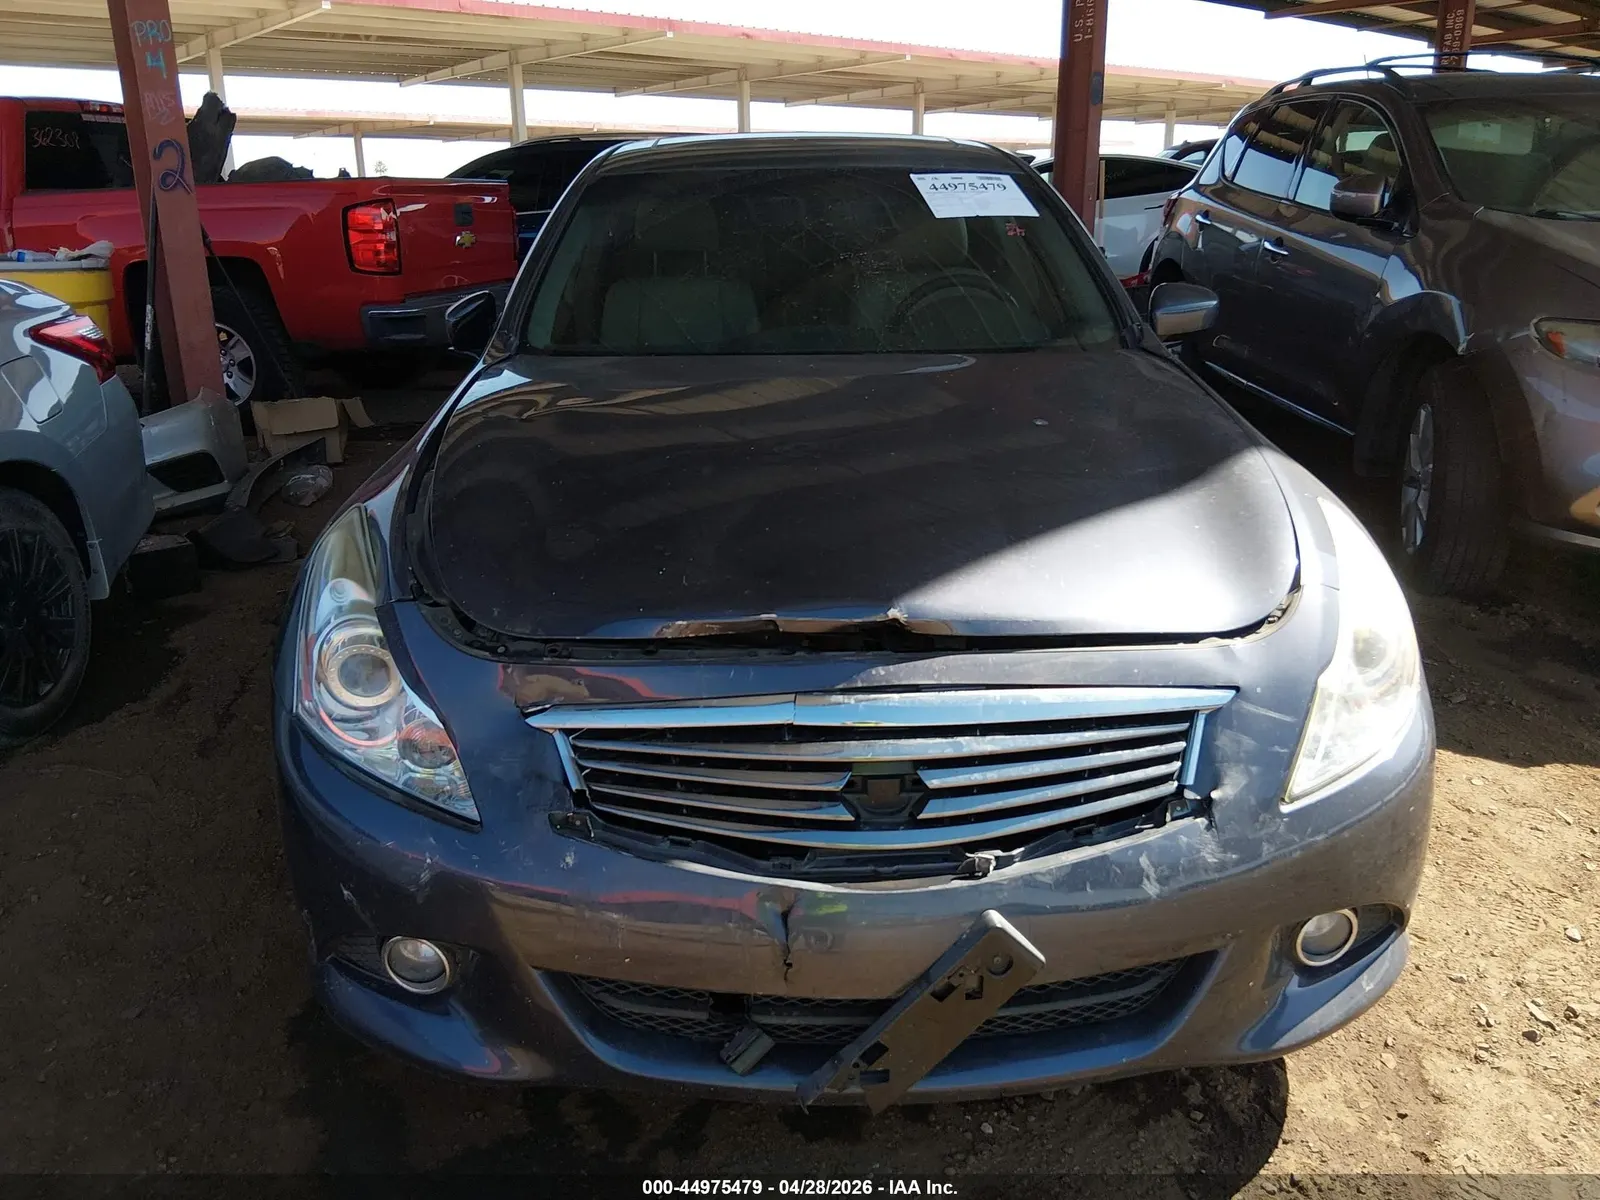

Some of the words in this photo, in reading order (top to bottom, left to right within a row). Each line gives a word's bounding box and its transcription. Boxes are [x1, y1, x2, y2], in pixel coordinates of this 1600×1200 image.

[1445, 8, 1457, 29] INC.
[152, 137, 194, 196] 2
[929, 182, 1007, 192] 44975479
